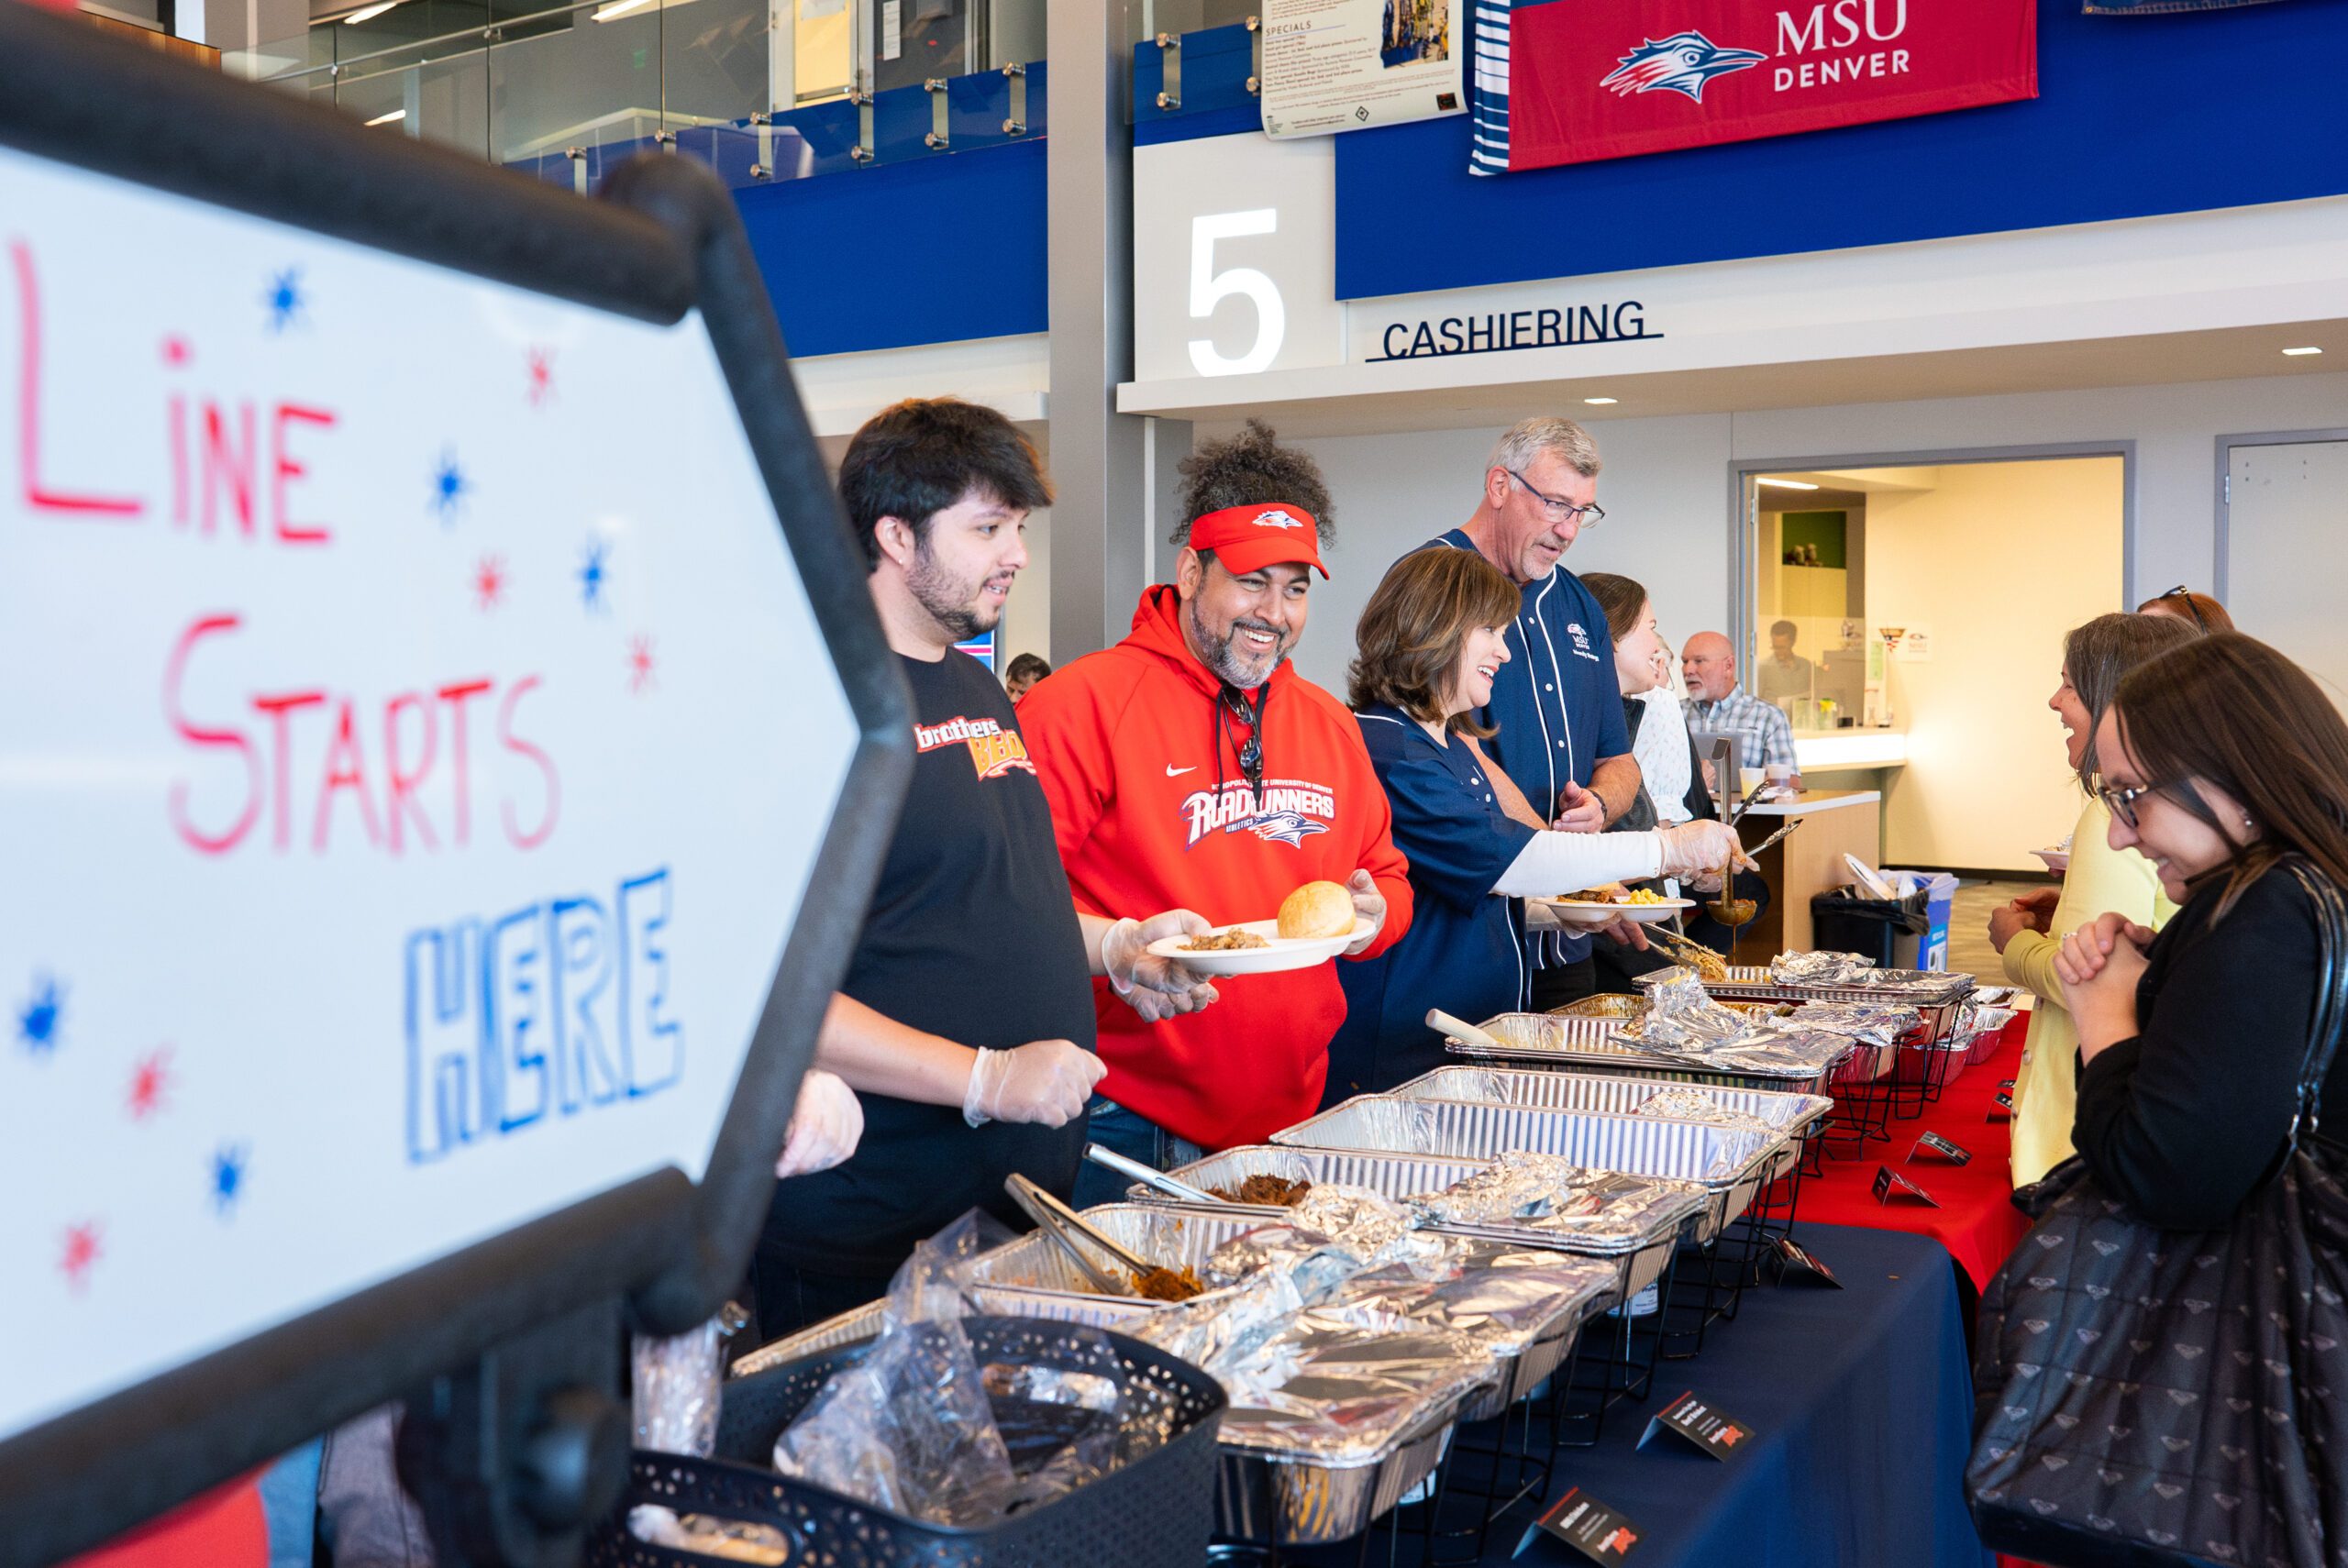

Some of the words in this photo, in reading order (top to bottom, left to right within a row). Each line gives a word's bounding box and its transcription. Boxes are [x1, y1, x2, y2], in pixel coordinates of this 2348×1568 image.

[1266, 20, 1312, 36] SPECIALS
[1775, 0, 1907, 57] MSU
[1774, 50, 1911, 93] DENVER
[1188, 207, 1286, 378] 5
[1383, 301, 1645, 359] CASHIERING
[914, 717, 1002, 750] brothers
[1269, 778, 1304, 788] UNIVERSITY
[1225, 817, 1254, 834] ATHLETICS
[402, 864, 688, 1165] HERE
